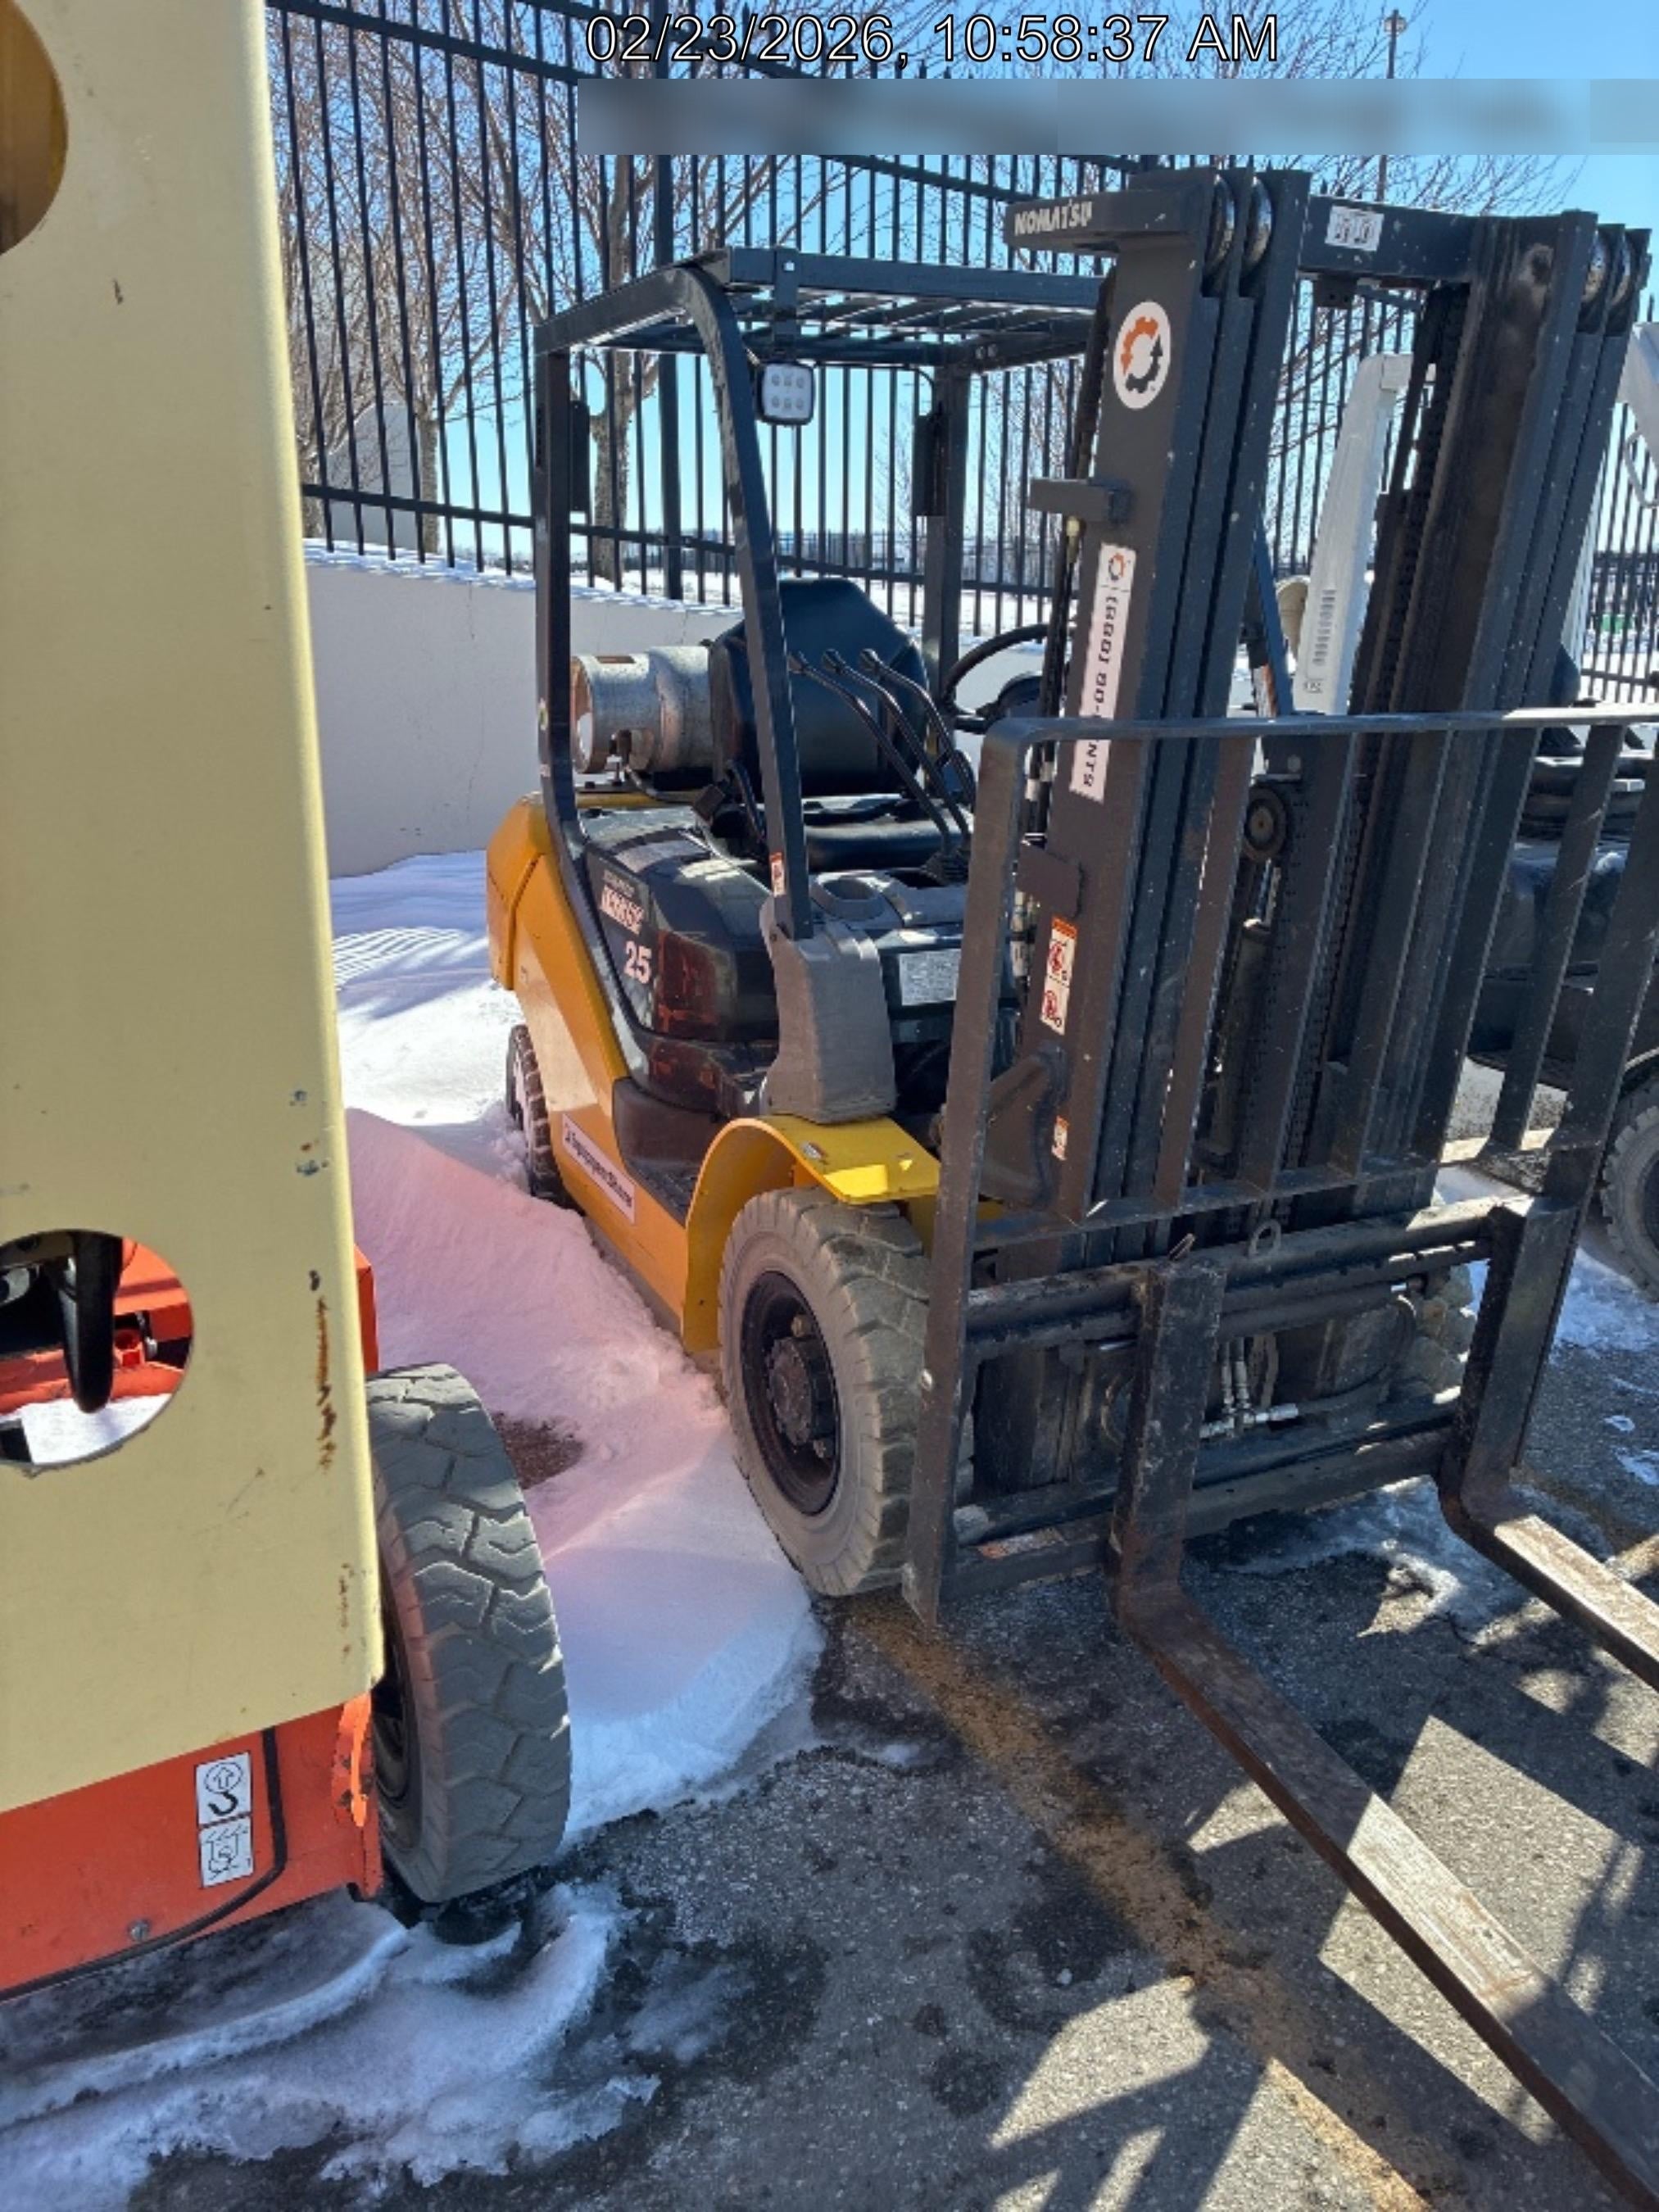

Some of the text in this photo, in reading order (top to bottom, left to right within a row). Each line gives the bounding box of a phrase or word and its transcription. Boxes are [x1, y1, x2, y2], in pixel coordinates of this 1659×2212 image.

[1014, 199, 1093, 236] KOMATSU
[1083, 673, 1108, 787] 80-NTS
[623, 941, 652, 984] 25
